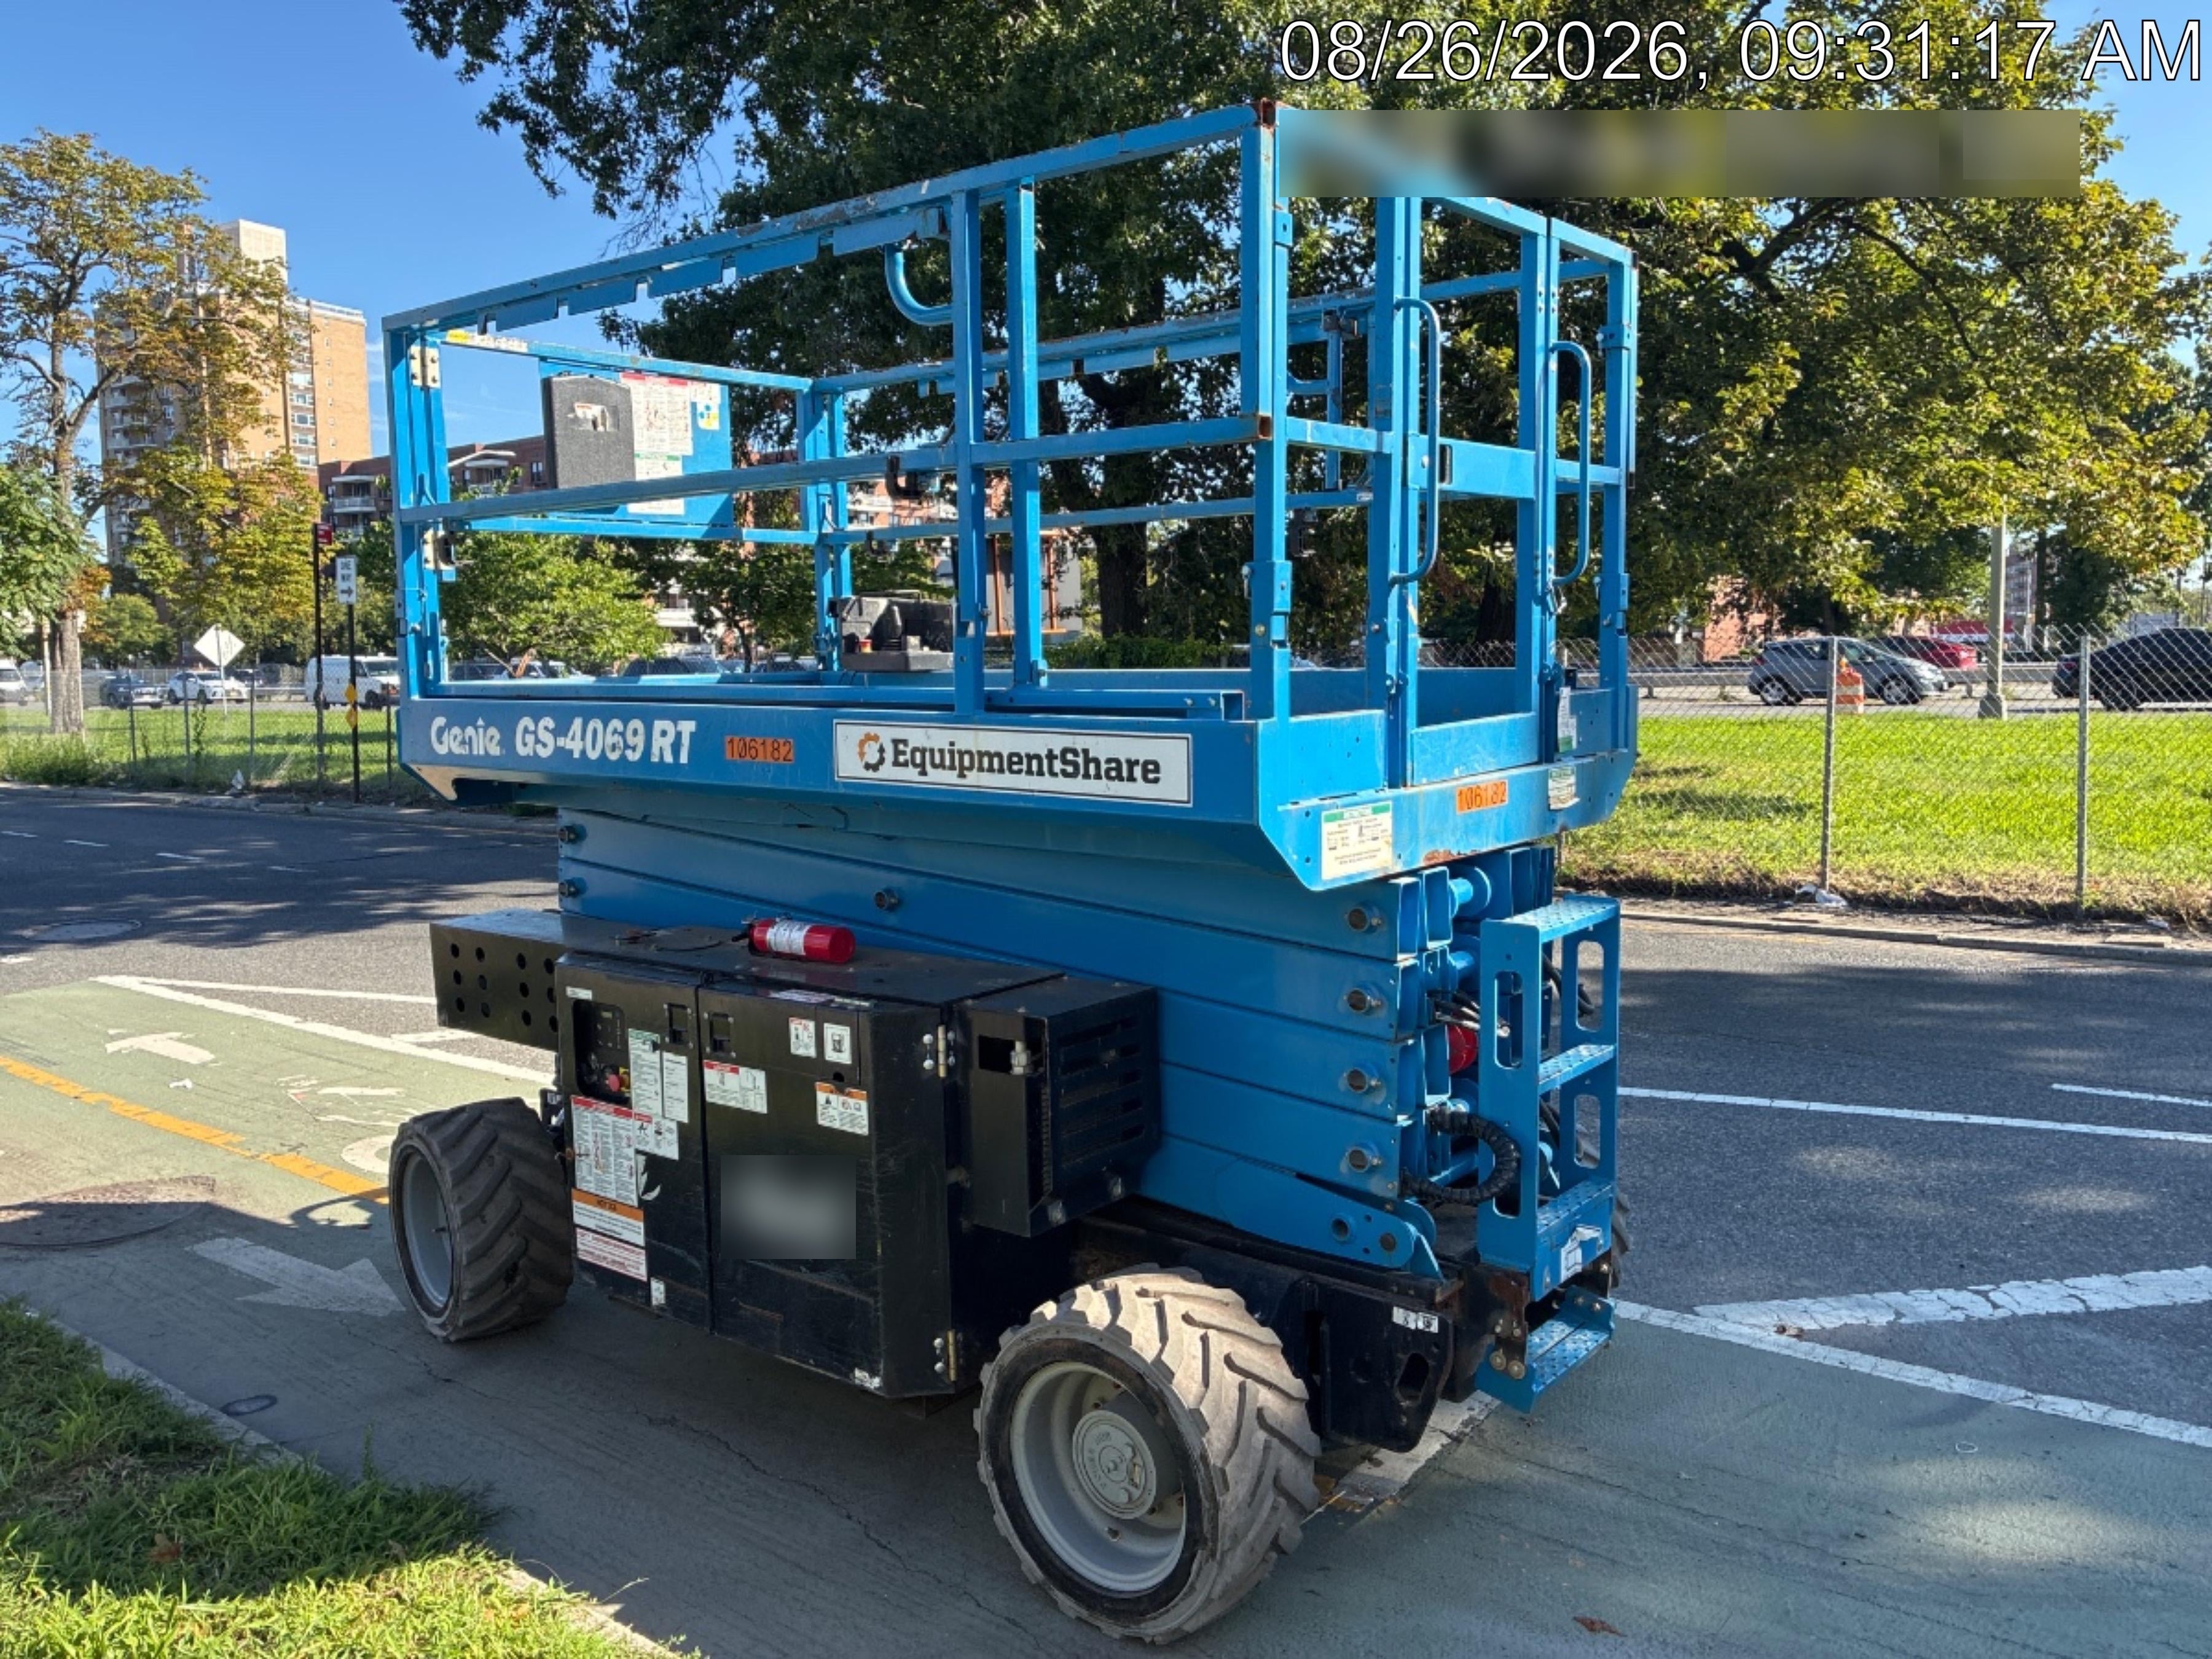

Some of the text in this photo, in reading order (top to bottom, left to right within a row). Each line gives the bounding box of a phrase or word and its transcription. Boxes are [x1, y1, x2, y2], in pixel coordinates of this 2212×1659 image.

[431, 716, 696, 764] Genie GS-4069 RT
[727, 737, 793, 763] 106182
[891, 738, 1161, 784] EquipmentShare
